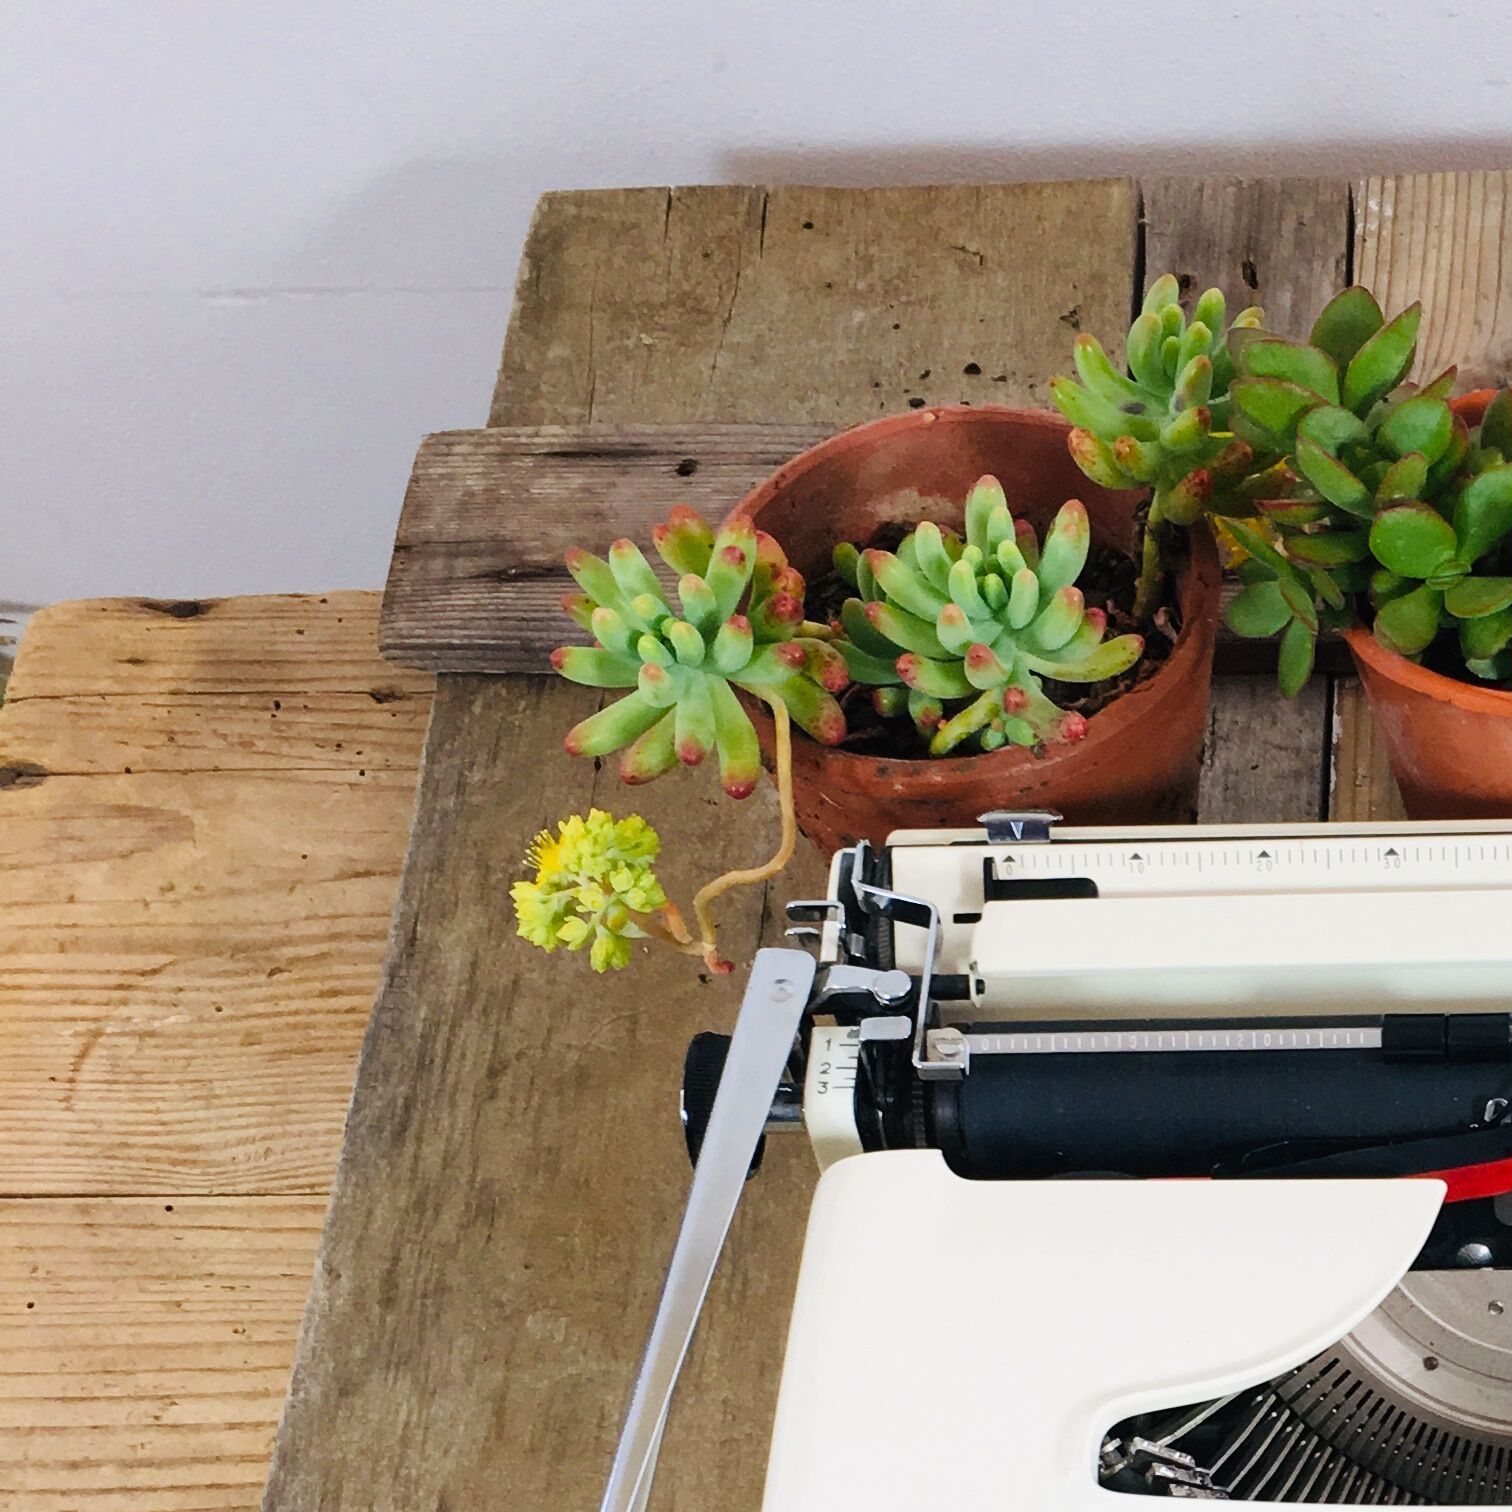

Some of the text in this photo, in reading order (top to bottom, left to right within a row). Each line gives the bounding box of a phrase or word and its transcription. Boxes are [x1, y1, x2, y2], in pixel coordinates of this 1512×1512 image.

[1005, 863, 1014, 877] 0
[1128, 861, 1145, 875] 10
[1255, 859, 1274, 872] 20
[1383, 856, 1401, 870] 30
[825, 1038, 832, 1052] 1
[820, 1062, 831, 1075] 2
[817, 1081, 829, 1094] 3
